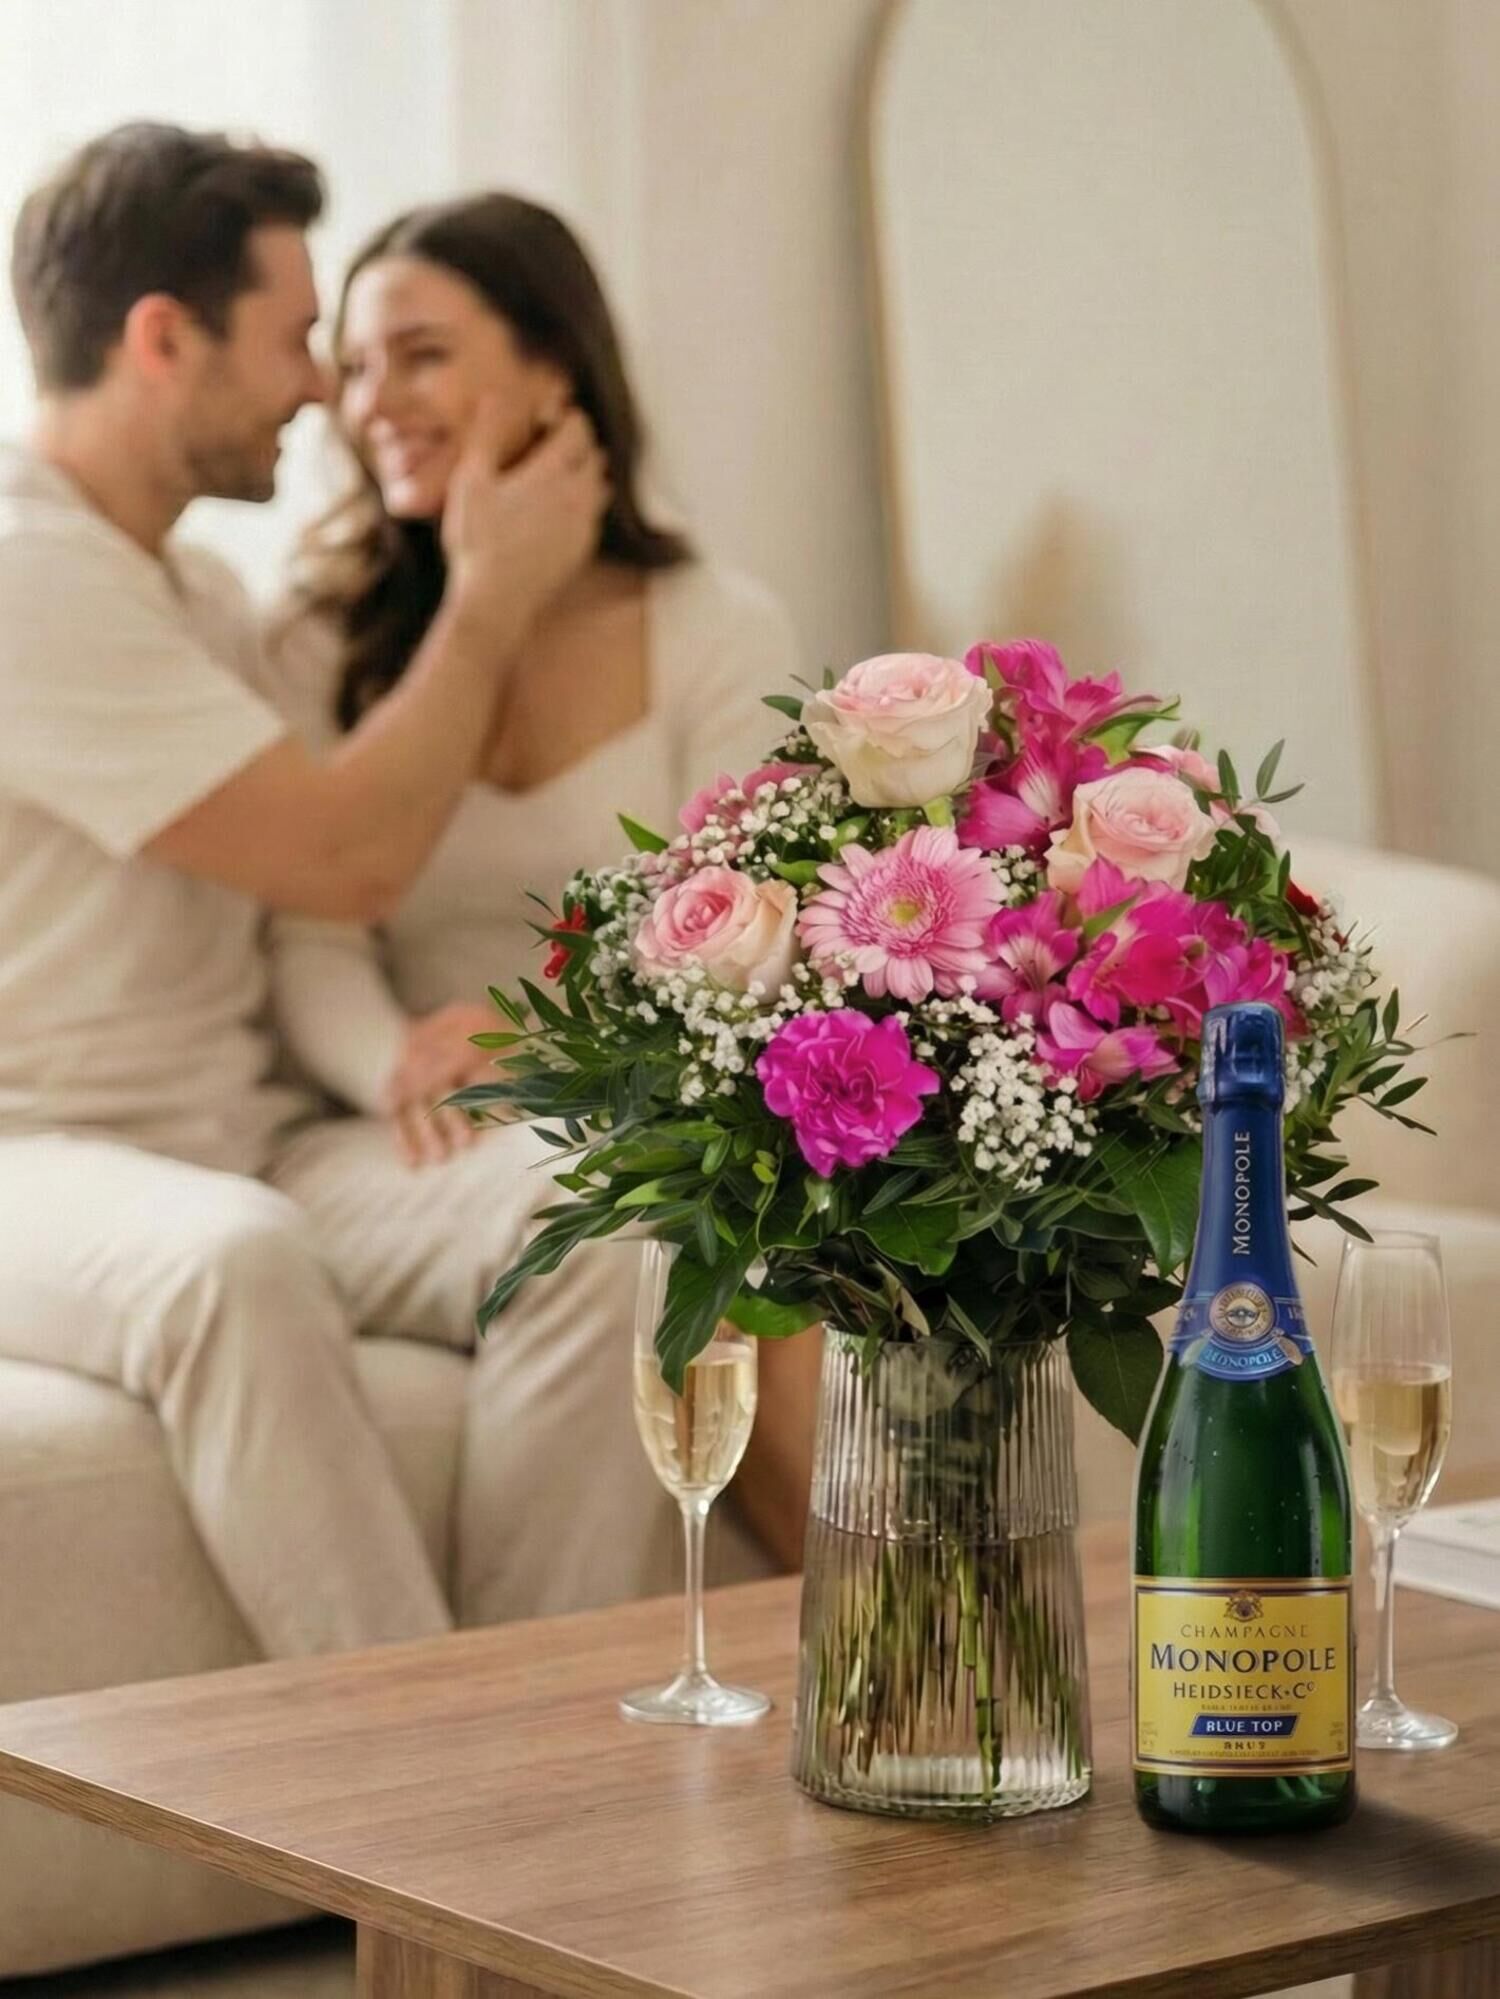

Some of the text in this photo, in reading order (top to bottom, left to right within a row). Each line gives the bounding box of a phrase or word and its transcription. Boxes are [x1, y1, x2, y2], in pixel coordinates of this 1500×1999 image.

[1233, 1131, 1250, 1255] MONOPOLE
[1180, 1624, 1309, 1639] CHAMPAGNE
[1151, 1643, 1336, 1673] MONOPOLE
[1206, 1720, 1283, 1733] BLUE TOP
